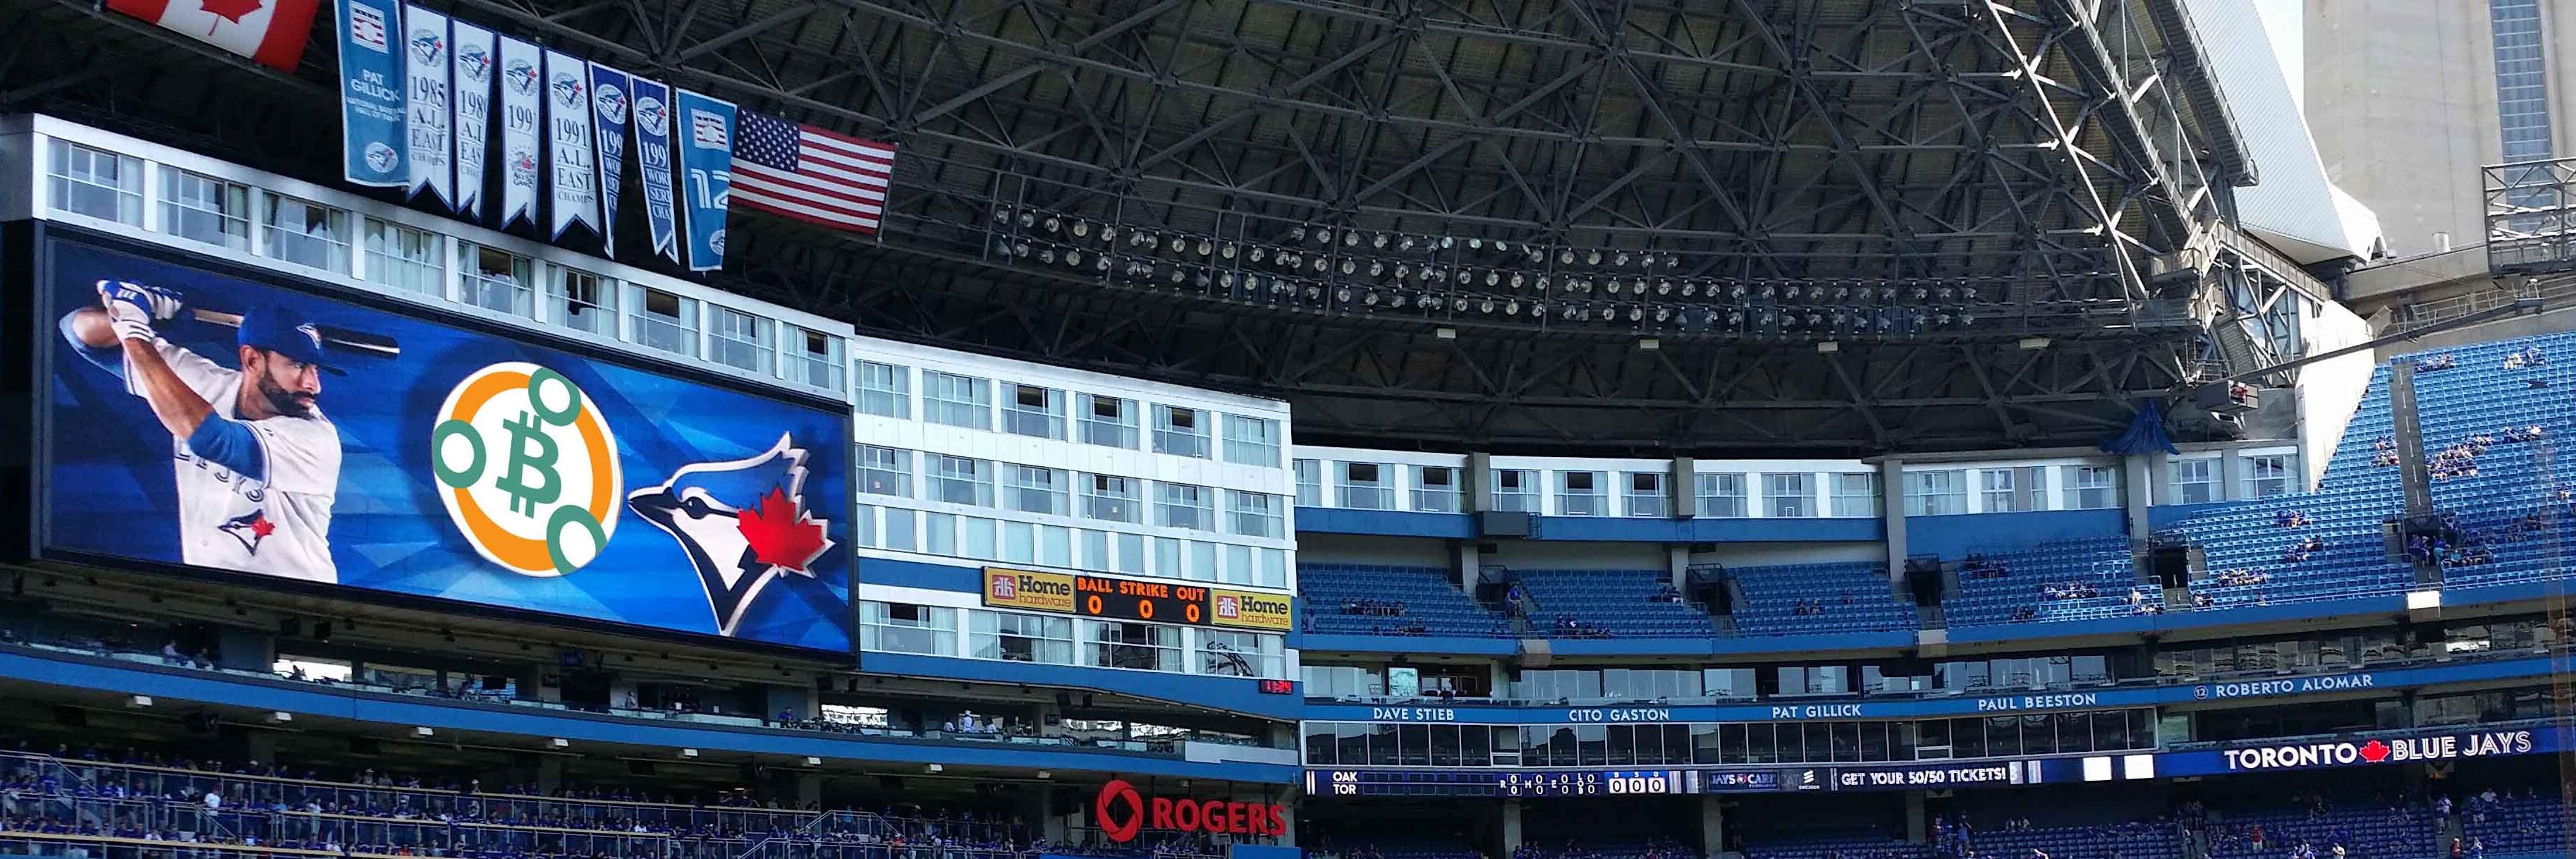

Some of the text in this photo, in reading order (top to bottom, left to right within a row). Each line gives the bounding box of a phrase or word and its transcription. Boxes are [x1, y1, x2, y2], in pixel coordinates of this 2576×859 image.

[362, 69, 384, 85] PAT
[350, 78, 401, 102] GILLICK
[413, 76, 444, 107] 1985
[412, 107, 445, 129] A.L.
[509, 105, 534, 130] 199
[412, 128, 445, 152] EAST
[556, 118, 587, 147] 1991
[602, 129, 623, 157] 199
[557, 148, 590, 169] A.L.
[643, 142, 666, 167] 199
[558, 168, 591, 190] EAST
[558, 192, 594, 203] CHAMPS
[649, 185, 670, 202] SERI
[690, 168, 730, 210] 12
[653, 205, 671, 221] CHA
[1018, 575, 1070, 596] Home
[1078, 578, 1205, 601] BALL STRIKE OUT
[1019, 593, 1071, 607] hardware
[1087, 595, 1200, 623] 0 0 0
[1240, 596, 1288, 615] Home
[1242, 613, 1288, 626] hardware
[2216, 680, 2293, 697] ROBERTO
[2302, 674, 2374, 690] ALOMAR
[1772, 705, 1862, 718] PAT GILLICK
[1978, 693, 2096, 711] PAUL BEESTON
[1373, 707, 1454, 721] DAVE STIEB
[1568, 709, 1670, 721] CITO GASTON
[2224, 731, 2532, 770] TORONTO BLUE JAYS
[1333, 771, 1594, 784] OAK 0 0 0 0
[1500, 780, 1507, 788] R
[1525, 780, 1532, 788] H
[1613, 779, 1661, 793] 0 0 0
[1711, 774, 1736, 785] JAYS
[1841, 772, 1866, 786] GET
[1869, 772, 1905, 785] YOUR
[1908, 770, 1945, 784] 50/50
[1948, 767, 2006, 783] TICKETS!
[1333, 784, 1594, 795] TOR 0 0 0 0
[1151, 798, 1287, 836] ROGERS
